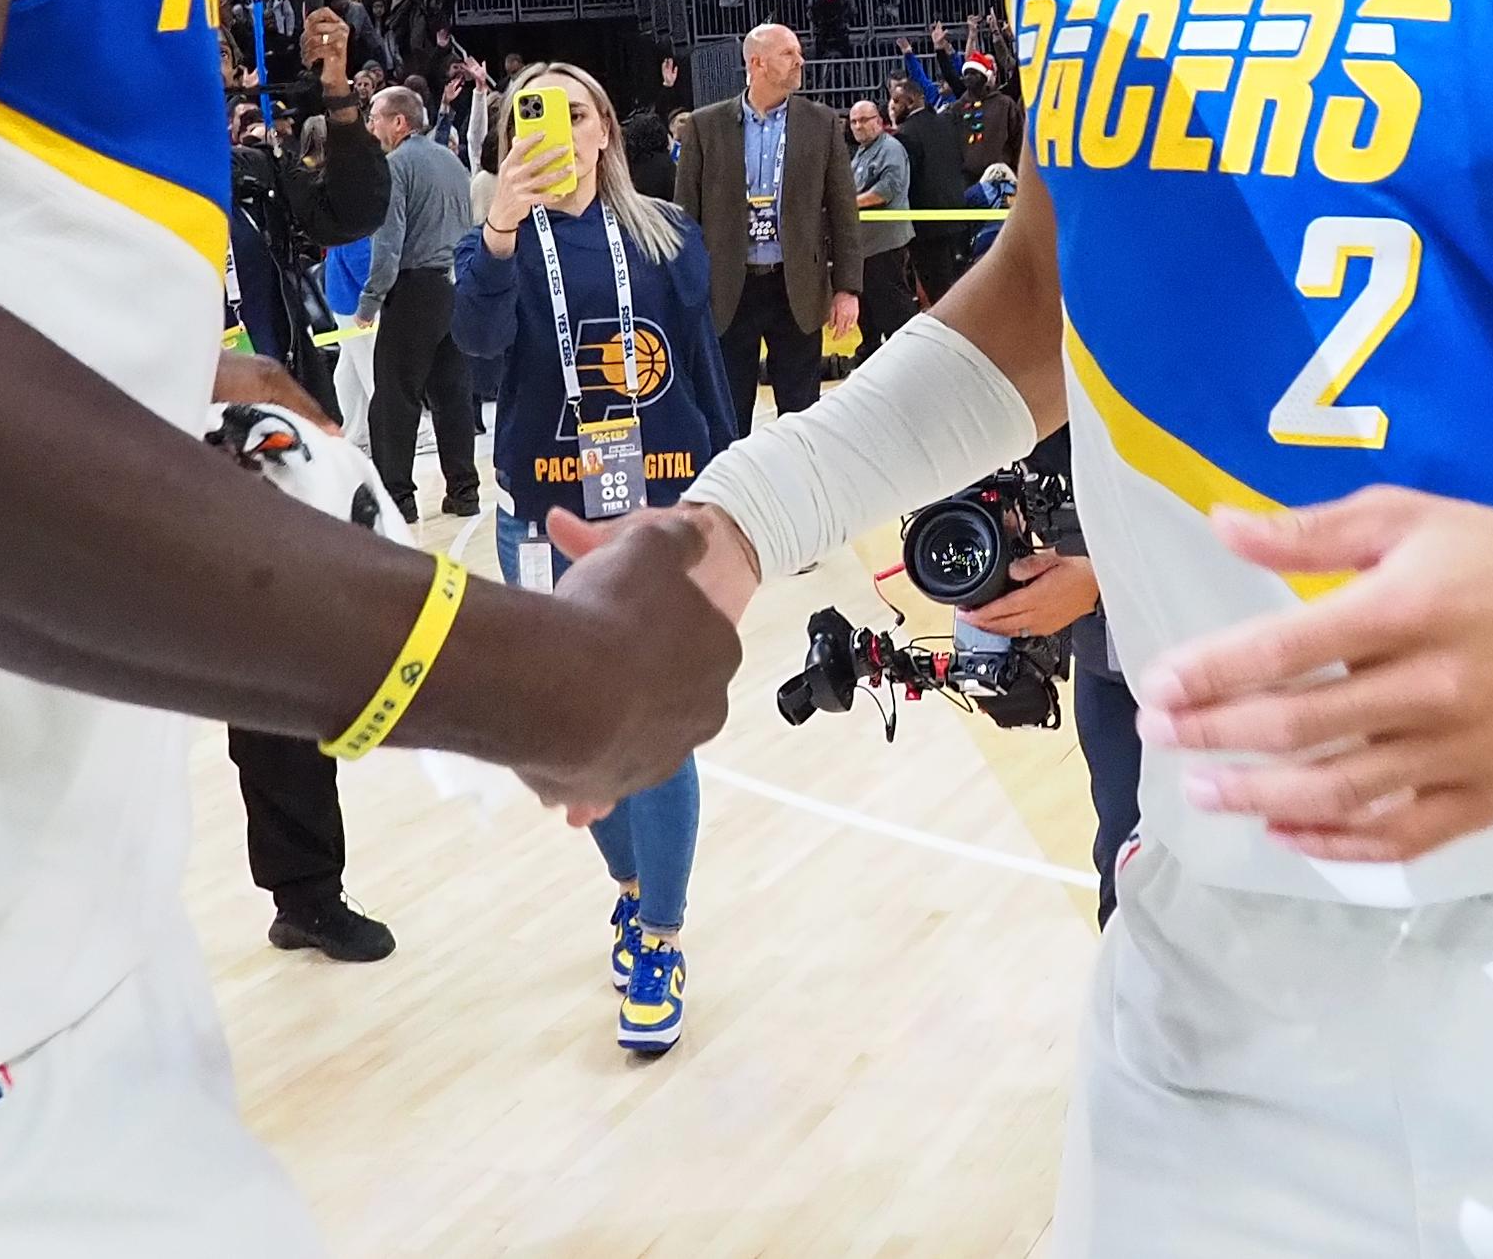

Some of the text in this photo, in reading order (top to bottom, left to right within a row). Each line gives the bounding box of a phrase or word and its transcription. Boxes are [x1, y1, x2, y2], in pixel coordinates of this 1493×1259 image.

[545, 247, 556, 265] YES
[557, 313, 568, 334] YES
[1268, 216, 1422, 450] 2
[623, 337, 633, 359] YES
[602, 500, 623, 512] TIER
